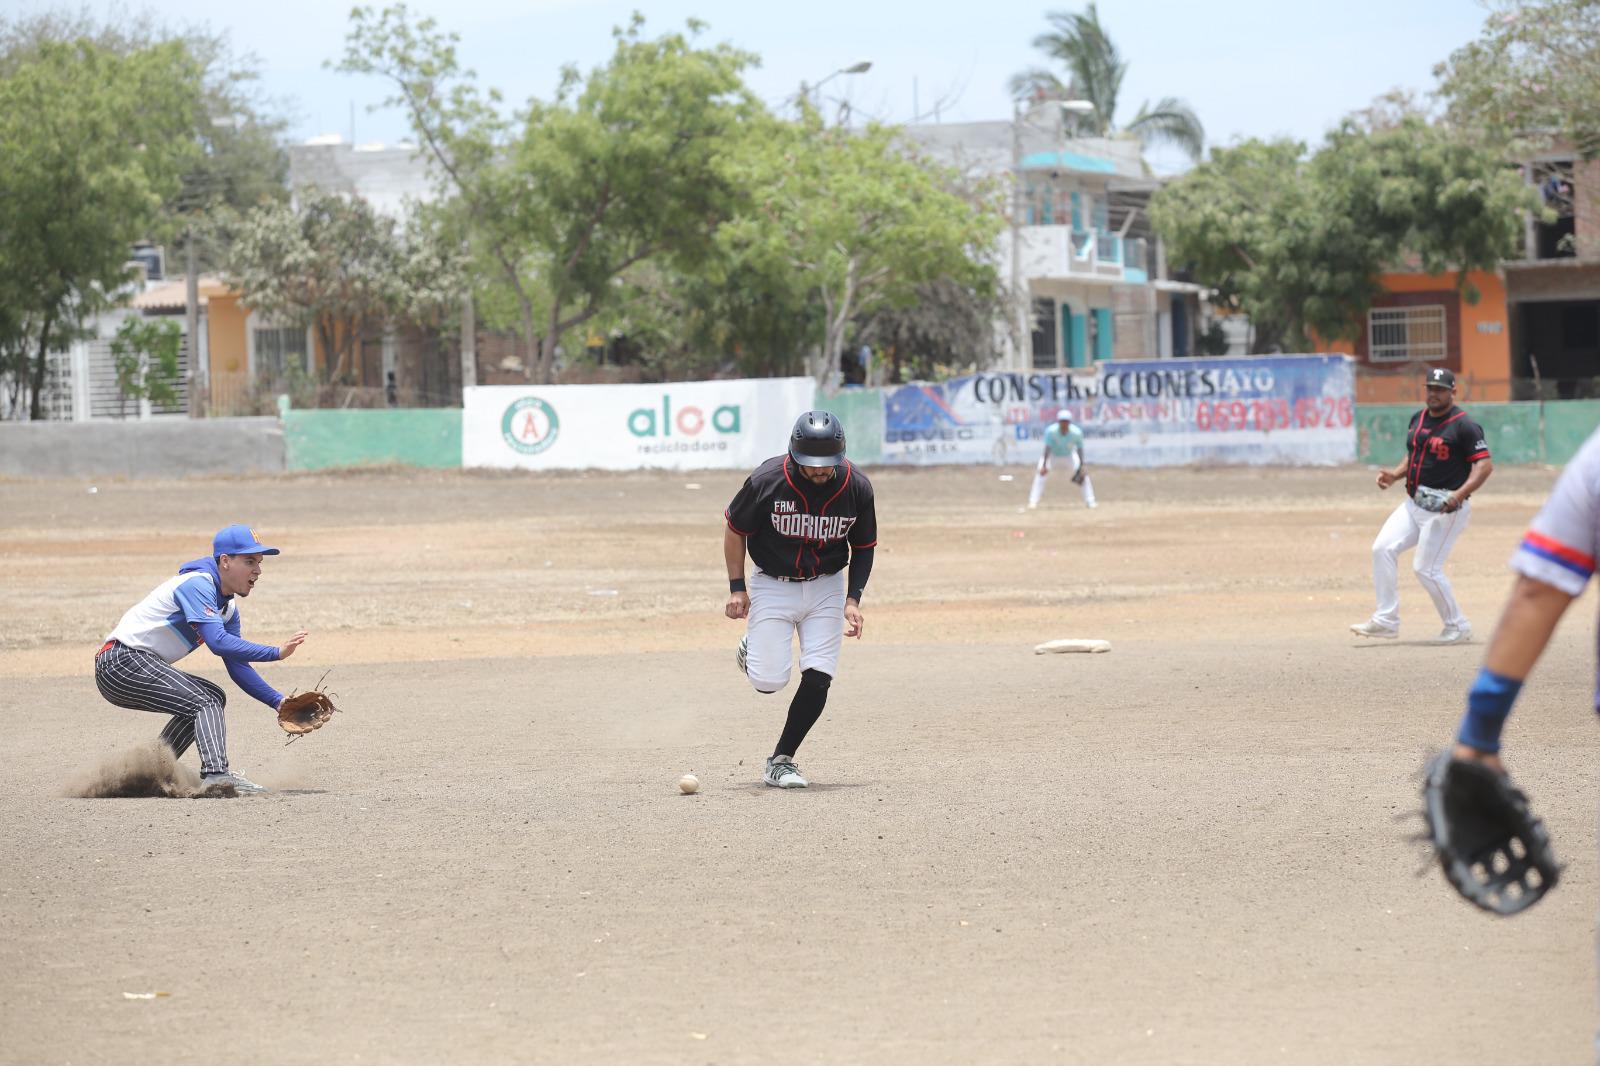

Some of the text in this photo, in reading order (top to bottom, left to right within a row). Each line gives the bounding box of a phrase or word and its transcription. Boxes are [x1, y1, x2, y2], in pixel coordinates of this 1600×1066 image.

[1433, 368, 1444, 380] T
[522, 410, 539, 439] A
[774, 501, 798, 513] FAM.
[771, 513, 857, 543] RODRIGUEZ
